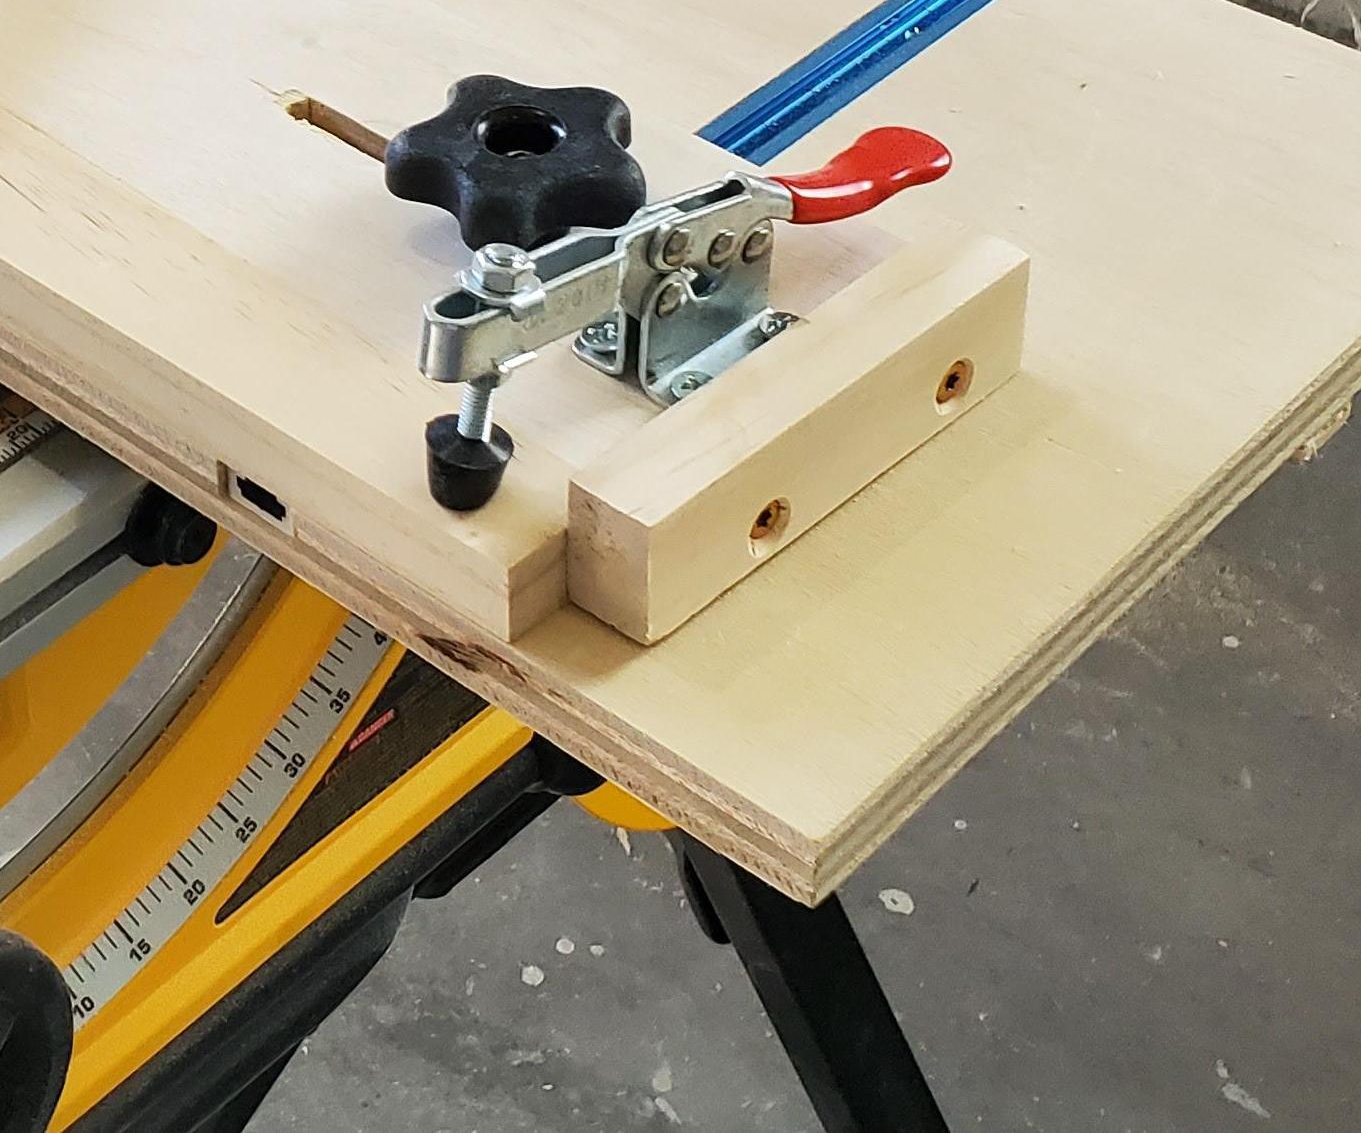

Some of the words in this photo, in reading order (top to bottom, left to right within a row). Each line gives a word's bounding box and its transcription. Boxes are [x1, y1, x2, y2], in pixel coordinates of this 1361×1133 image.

[6, 424, 29, 440] 20
[372, 631, 388, 647] 4
[329, 688, 351, 714] 35
[283, 753, 306, 778] 30
[234, 817, 258, 844] 25
[182, 879, 206, 906] 20
[129, 939, 152, 962] 15
[72, 996, 95, 1019] 10
